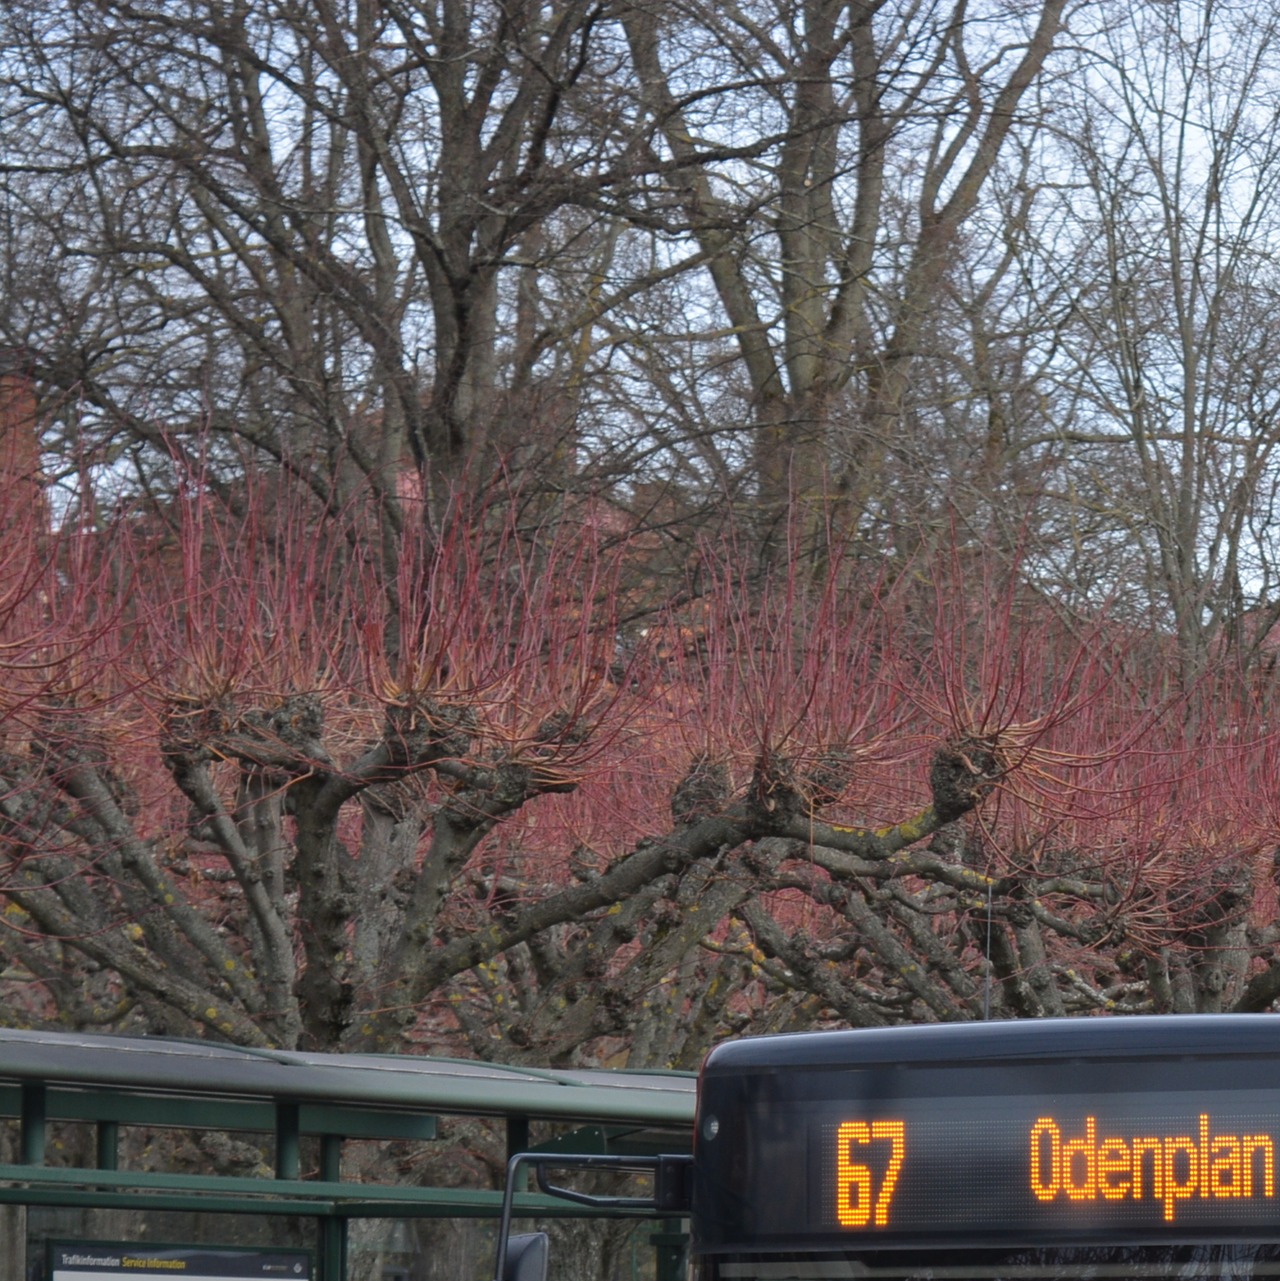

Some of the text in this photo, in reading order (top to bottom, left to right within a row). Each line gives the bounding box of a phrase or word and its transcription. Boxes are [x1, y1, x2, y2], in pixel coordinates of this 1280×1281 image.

[838, 1114, 1273, 1225] 67 Odenplan
[62, 1254, 186, 1270] Trafikinformation Service Information
